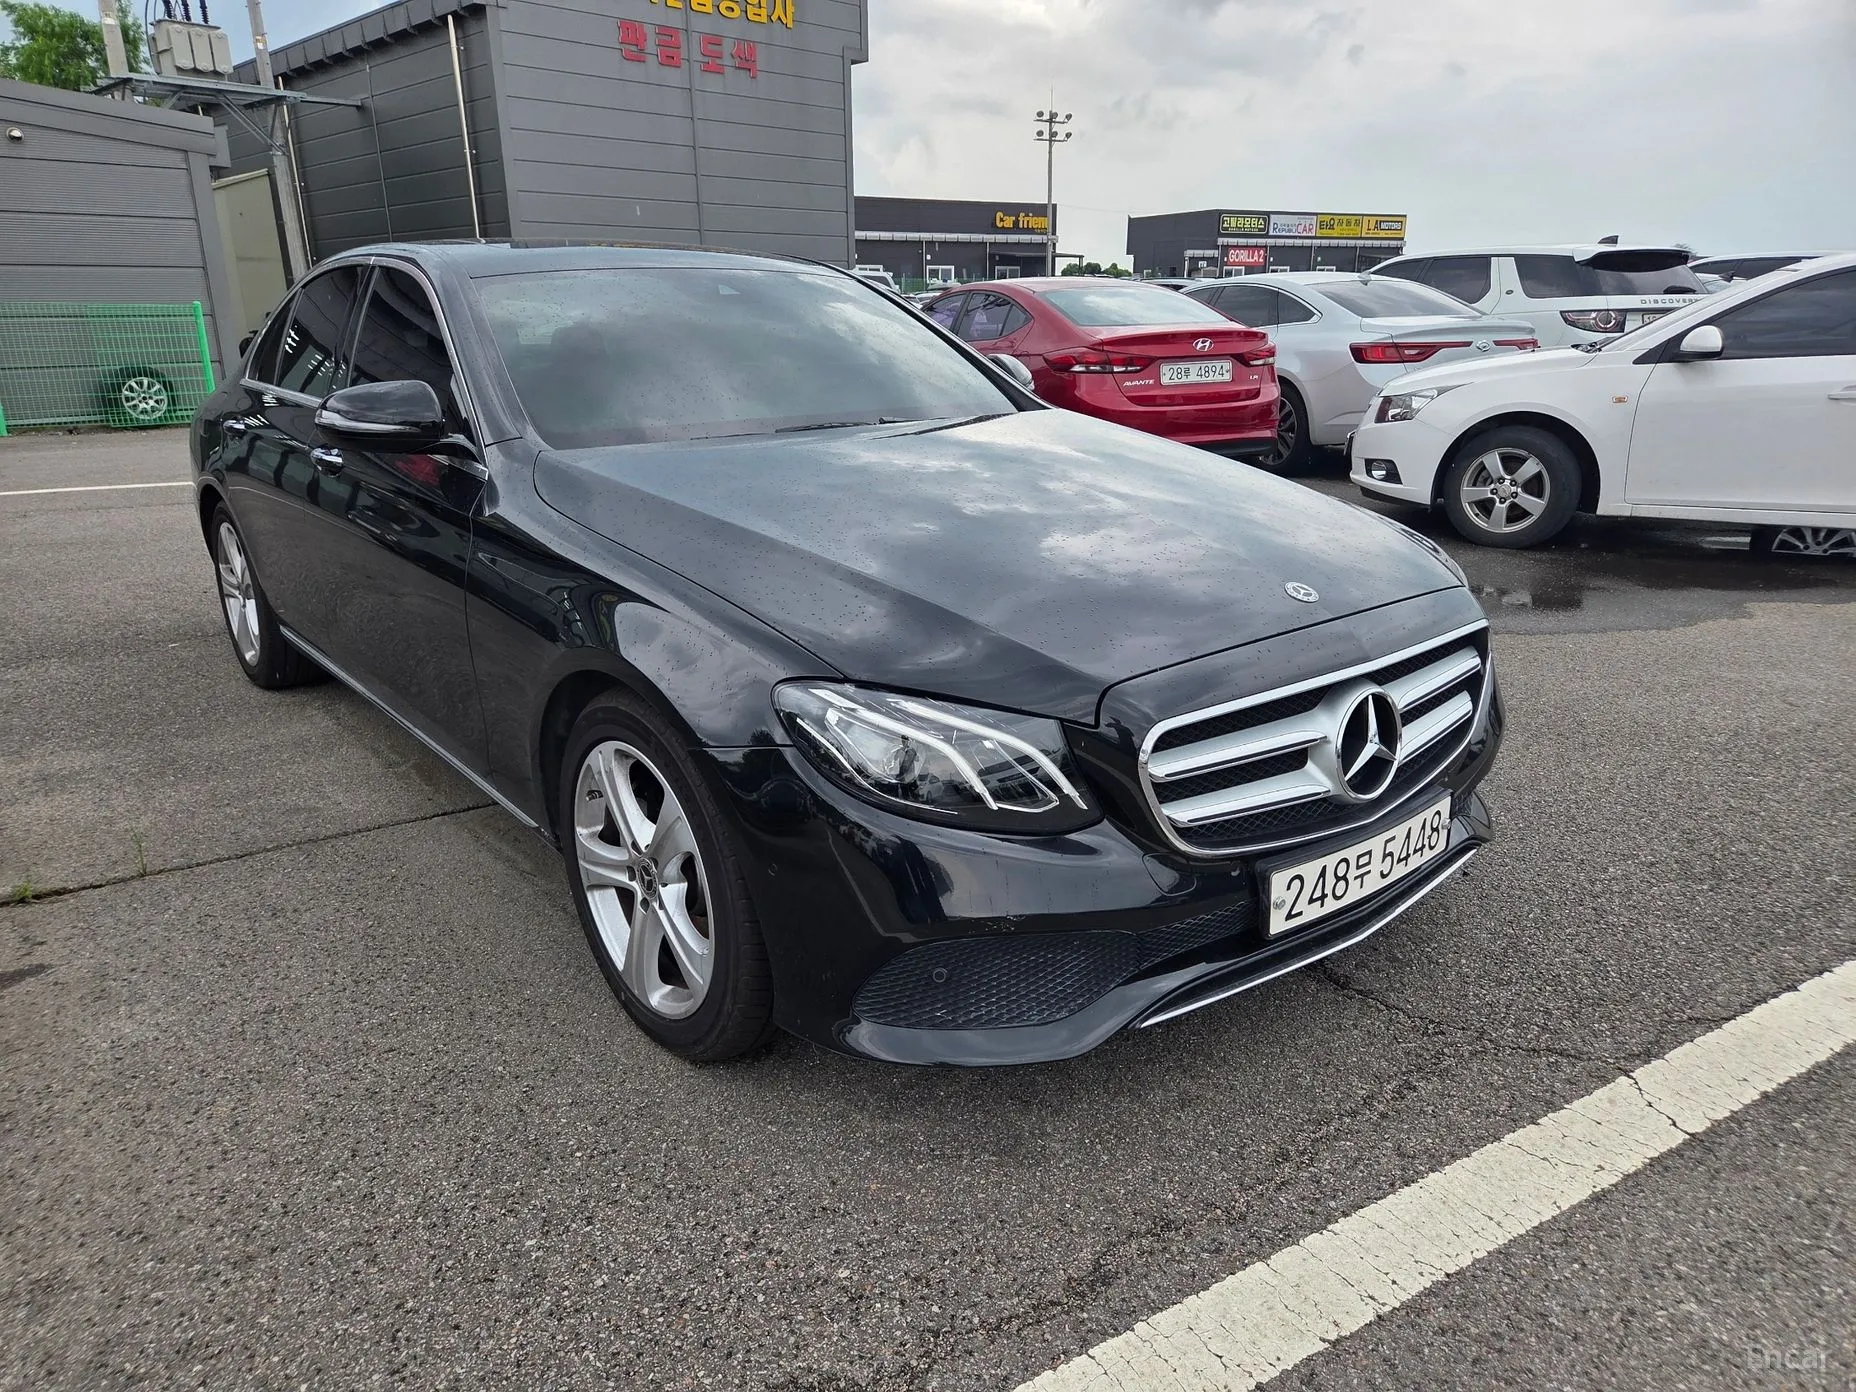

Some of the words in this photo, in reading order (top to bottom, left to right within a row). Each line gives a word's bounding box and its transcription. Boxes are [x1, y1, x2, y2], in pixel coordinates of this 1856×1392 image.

[617, 20, 682, 68] 판금
[699, 33, 759, 78] 도색
[995, 211, 1015, 228] Car
[1018, 212, 1048, 229] frien
[1228, 249, 1258, 262] GORILLA
[1196, 364, 1225, 379] 4894
[1123, 379, 1154, 387] AVANTE
[1284, 848, 1373, 922] 248무
[1379, 809, 1442, 880] 5448
